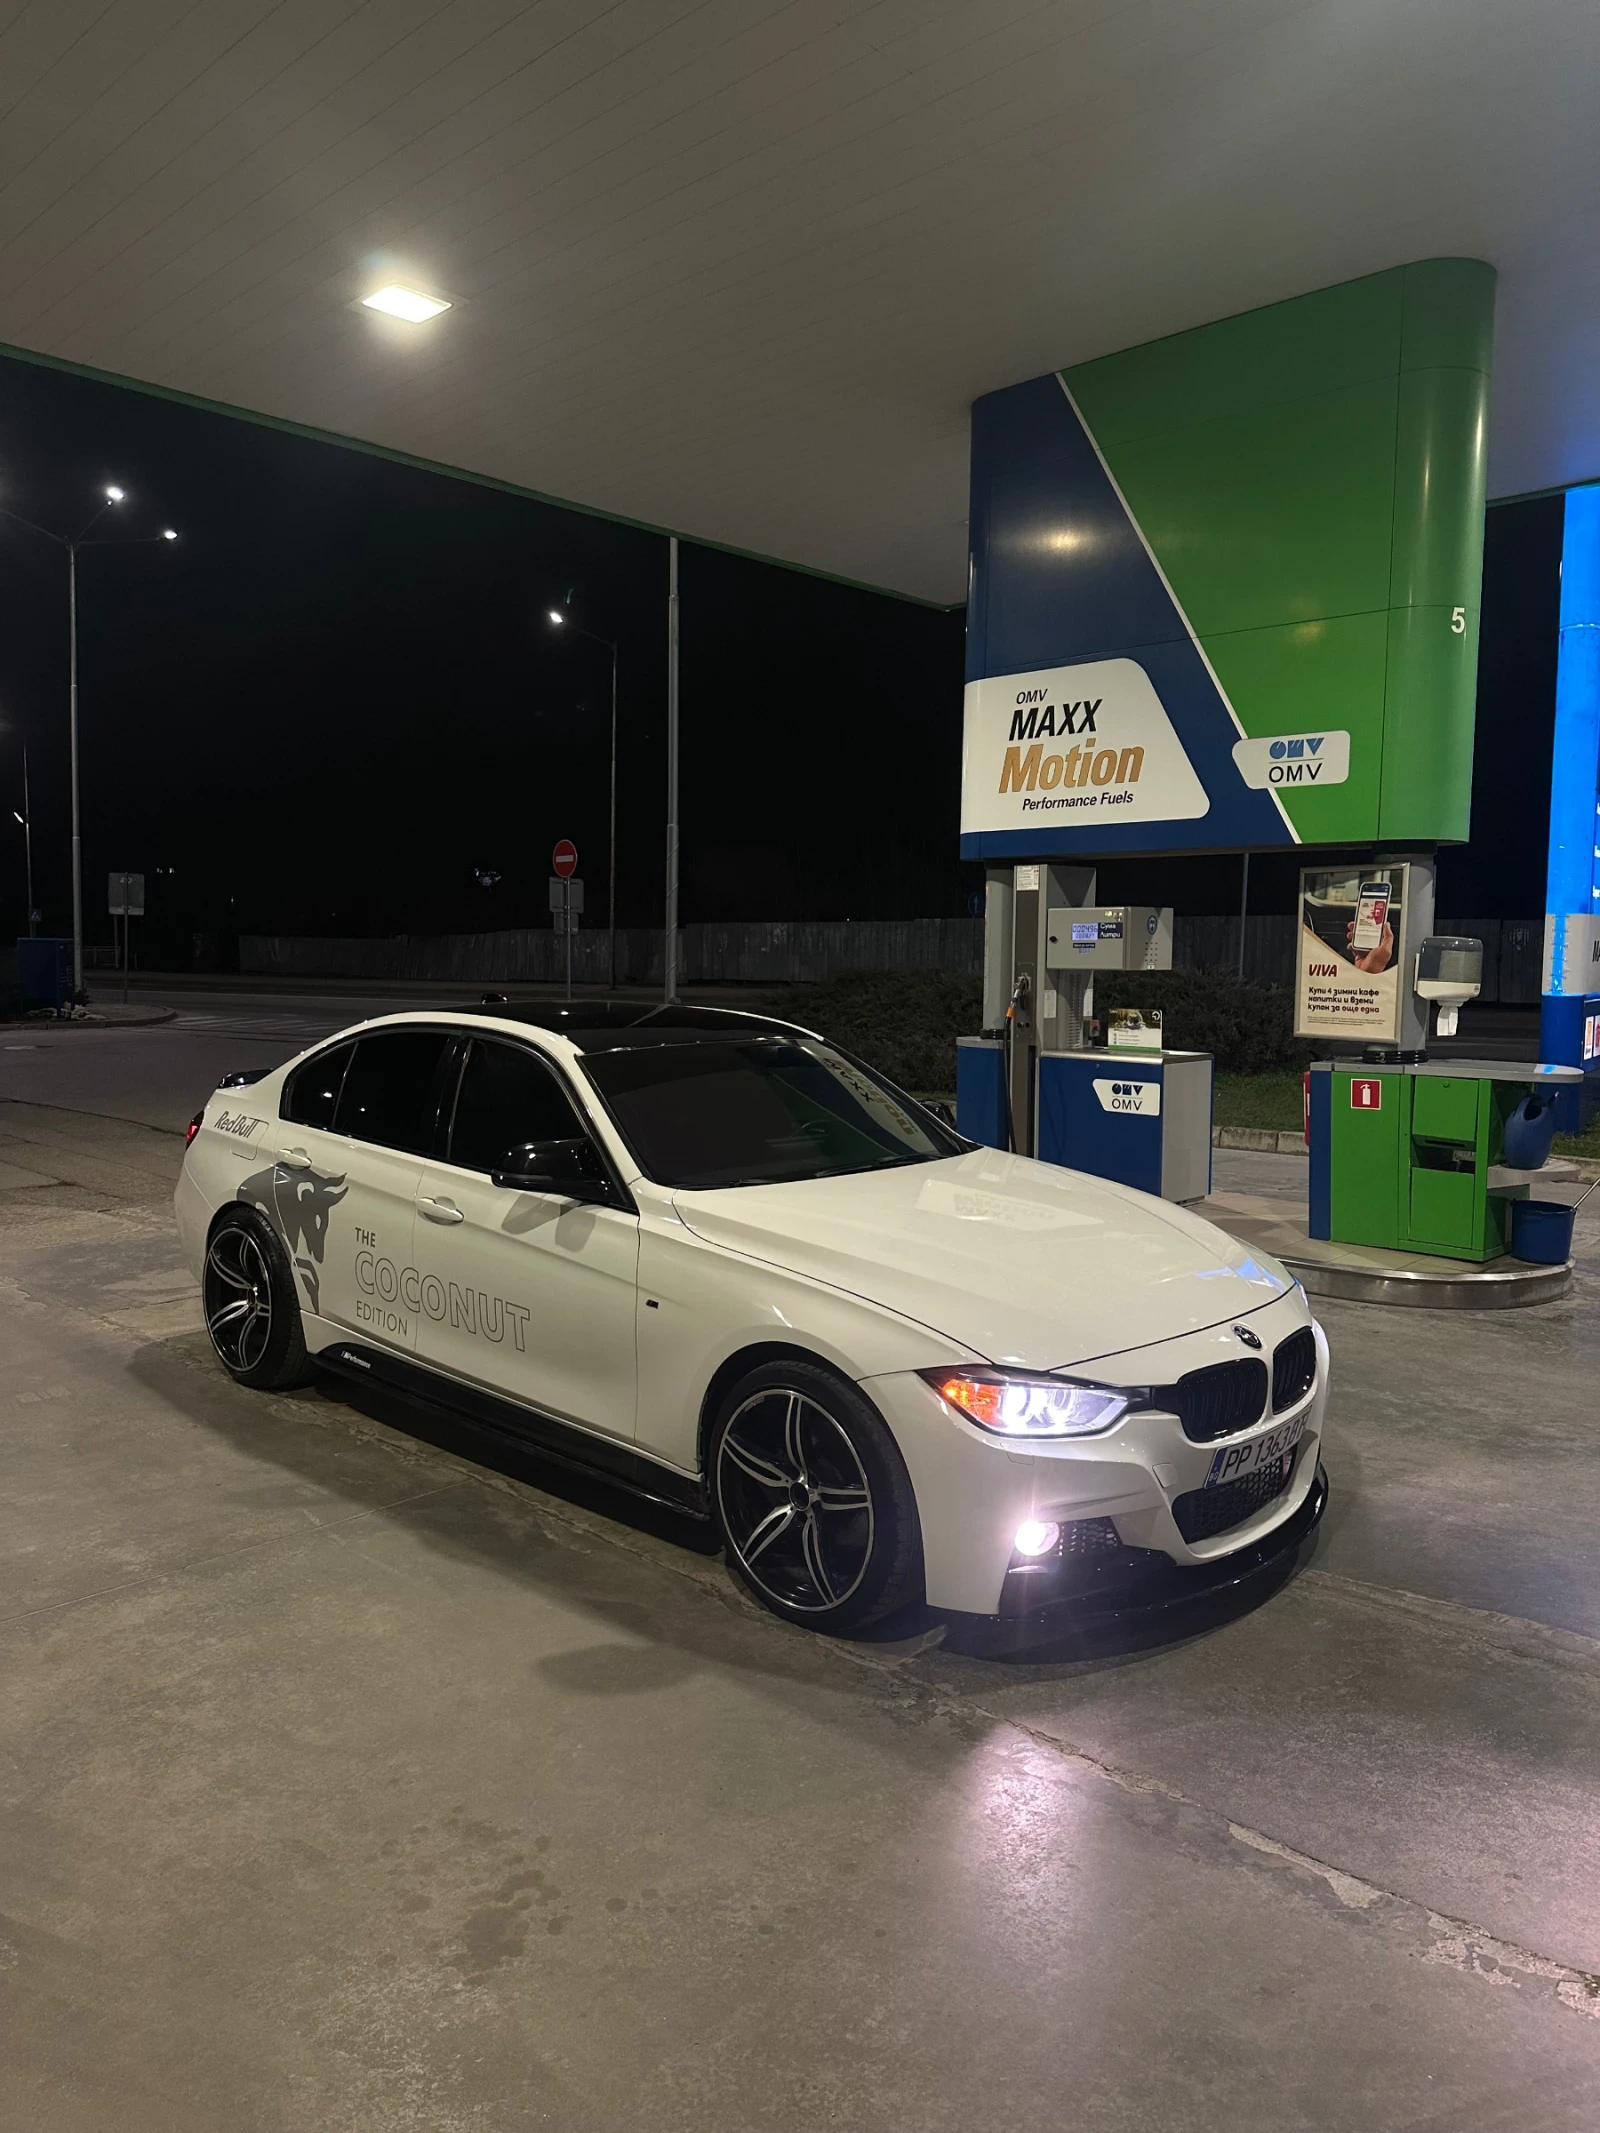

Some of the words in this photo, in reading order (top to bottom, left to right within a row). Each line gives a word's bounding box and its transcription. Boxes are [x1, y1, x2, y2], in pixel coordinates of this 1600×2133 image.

[1450, 606, 1465, 634] 5
[1016, 688, 1048, 704] OMV
[1008, 698, 1103, 741] MAXX
[998, 737, 1145, 794] Motion
[1268, 762, 1323, 783] OMV
[1022, 796, 1097, 811] Performance
[1100, 790, 1134, 805] Fuels
[1308, 963, 1338, 978] VIVA
[1308, 986, 1326, 996] Купи
[1327, 987, 1332, 995] 4
[1333, 988, 1358, 997] зимни
[1358, 988, 1380, 998] кафе
[1308, 995, 1343, 1004] напитки
[1350, 996, 1374, 1006] вземи
[1307, 1003, 1330, 1012] купон
[1331, 1005, 1341, 1013] за
[1341, 1006, 1359, 1014] още
[1360, 1006, 1380, 1015] една
[1111, 1098, 1143, 1111] OMV
[354, 1226, 376, 1249] THE
[354, 1250, 531, 1352] COCONUT
[355, 1299, 408, 1338] EDITION
[1222, 1444, 1253, 1478] PP
[1255, 1425, 1291, 1466] 1363
